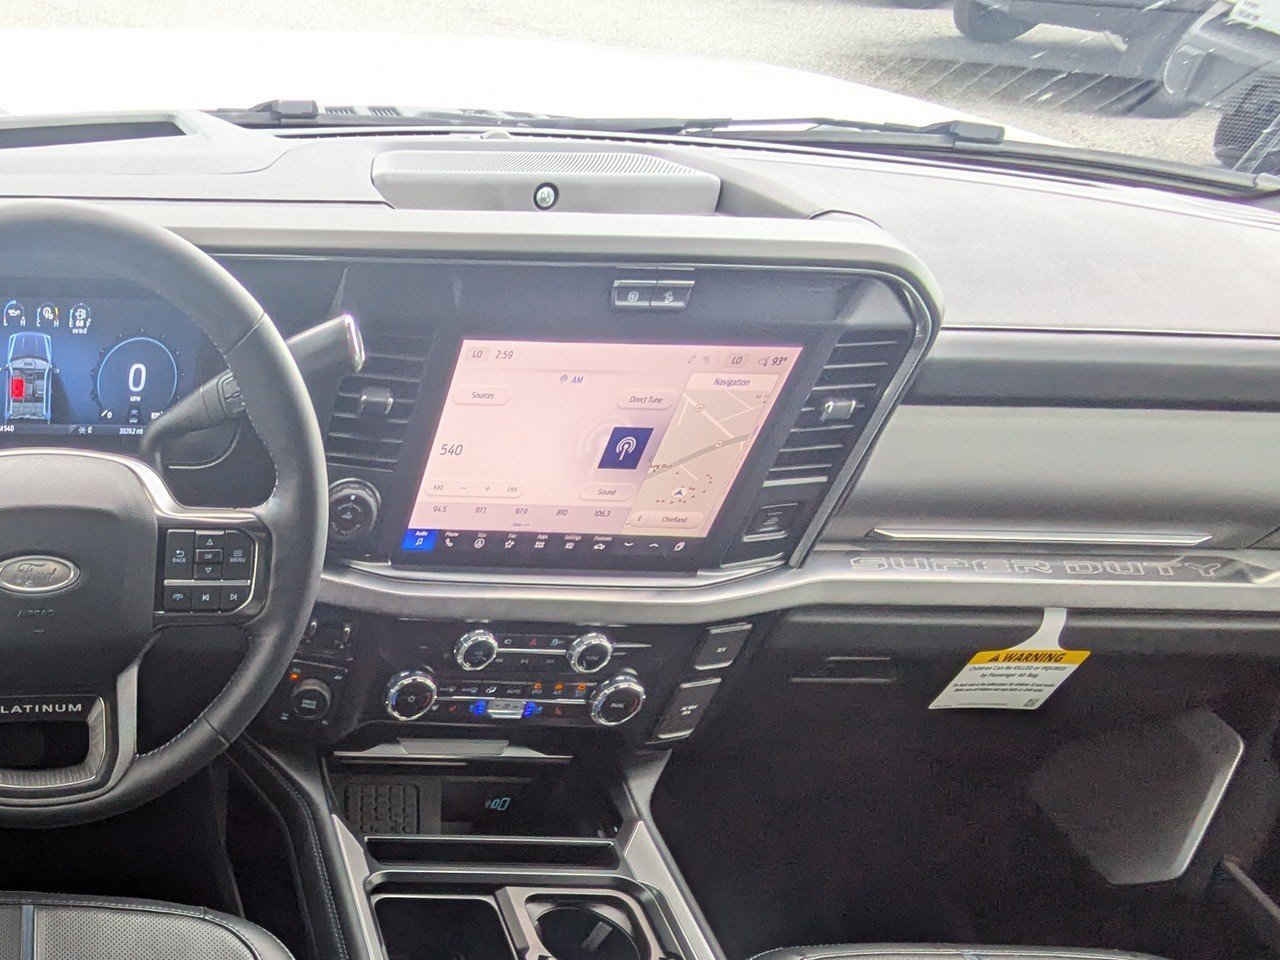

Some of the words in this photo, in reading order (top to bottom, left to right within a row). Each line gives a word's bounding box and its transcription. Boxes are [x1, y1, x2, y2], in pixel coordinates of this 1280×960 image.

[472, 350, 483, 358] LO
[494, 350, 514, 359] 2:59
[731, 356, 743, 364] LO
[128, 363, 147, 392] 0
[570, 376, 584, 384] AM
[713, 377, 751, 388] Navigation
[470, 391, 495, 400] Sources
[629, 395, 647, 404] Direct
[647, 395, 664, 404] Tune
[4, 424, 15, 432] 540
[439, 443, 464, 456] 540
[597, 488, 617, 496] Sound
[432, 505, 447, 514] 94.5
[514, 507, 529, 515] 97.9
[594, 509, 611, 517] 106.3
[850, 557, 1051, 574] SUPER
[1063, 560, 1221, 576] DUTY
[1002, 653, 1066, 663] WARNING
